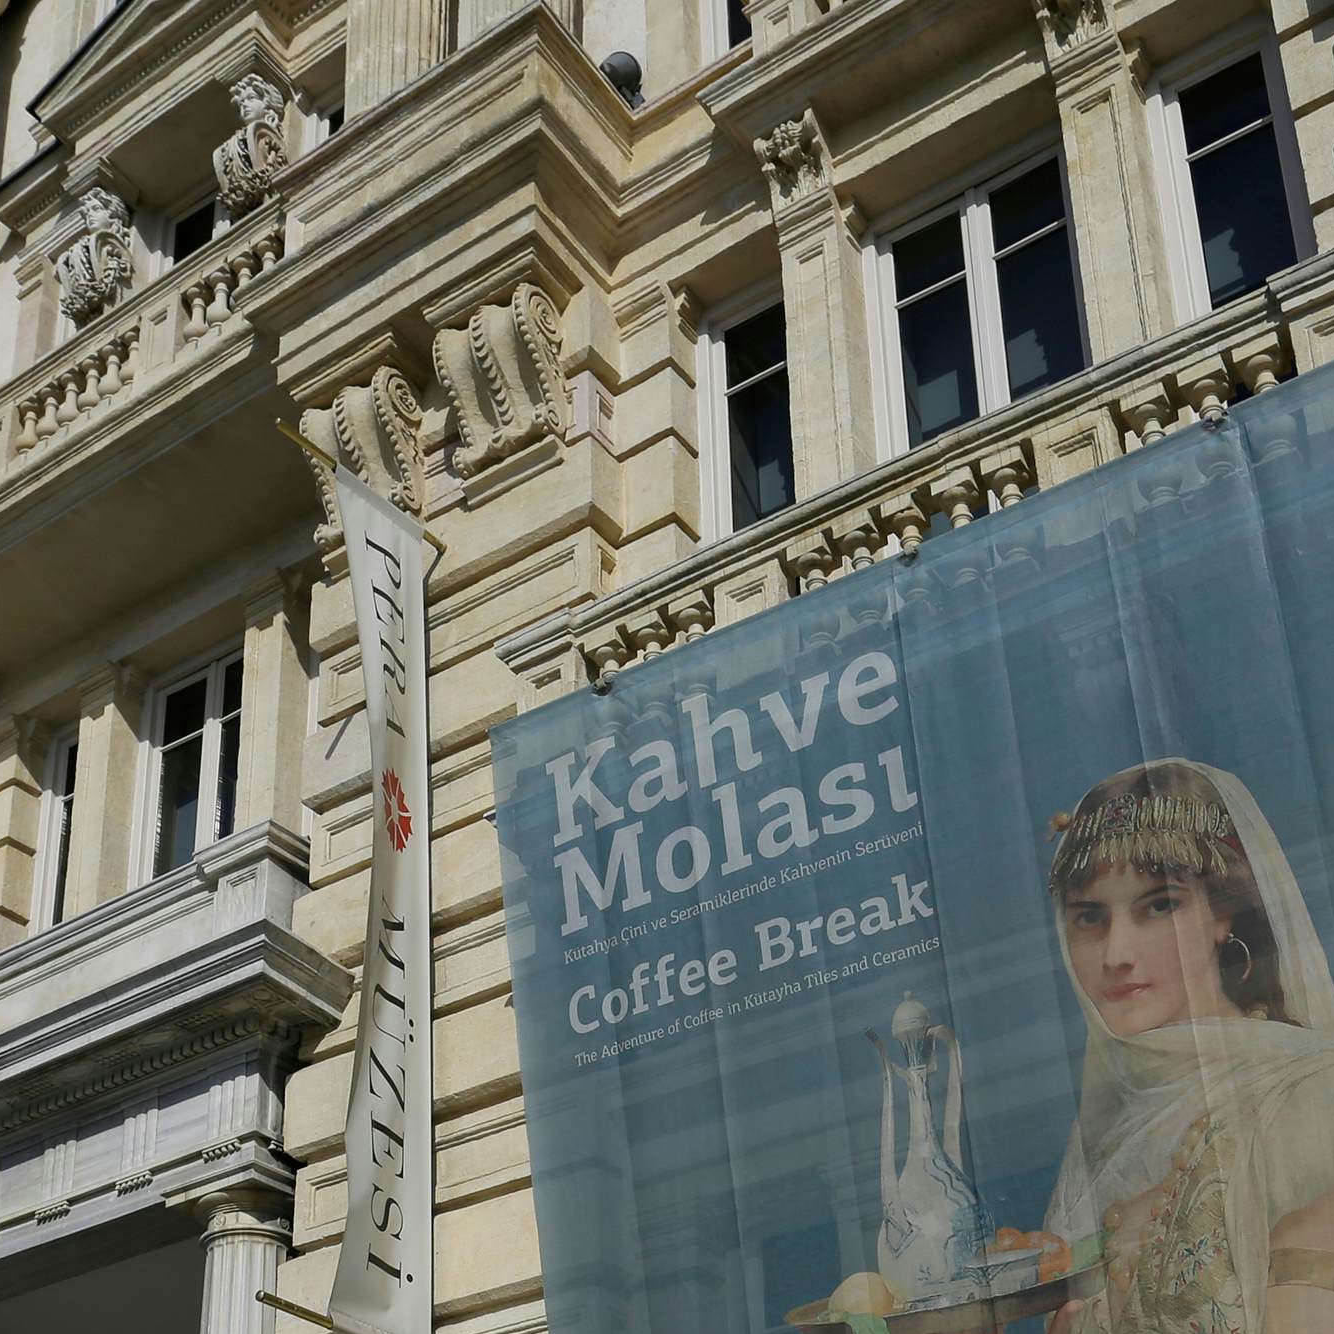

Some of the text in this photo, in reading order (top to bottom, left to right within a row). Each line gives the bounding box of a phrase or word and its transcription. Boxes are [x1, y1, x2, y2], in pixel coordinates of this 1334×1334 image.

[546, 651, 899, 848] Kahve
[363, 529, 415, 1288] PERA MÜZESİ
[554, 745, 918, 937] Molası
[563, 820, 924, 964] Kütahya Çini ve Seramiklerinde Kahvenin Serüveni
[569, 872, 934, 1035] Coffee Break
[574, 1050, 597, 1068] The
[601, 1025, 665, 1059] Adventure
[667, 1020, 681, 1036] of
[683, 1006, 724, 1030] Coffee
[727, 1000, 741, 1016] in
[804, 970, 838, 990] Tiles
[841, 955, 869, 978] and
[872, 934, 940, 967] Ceramics
